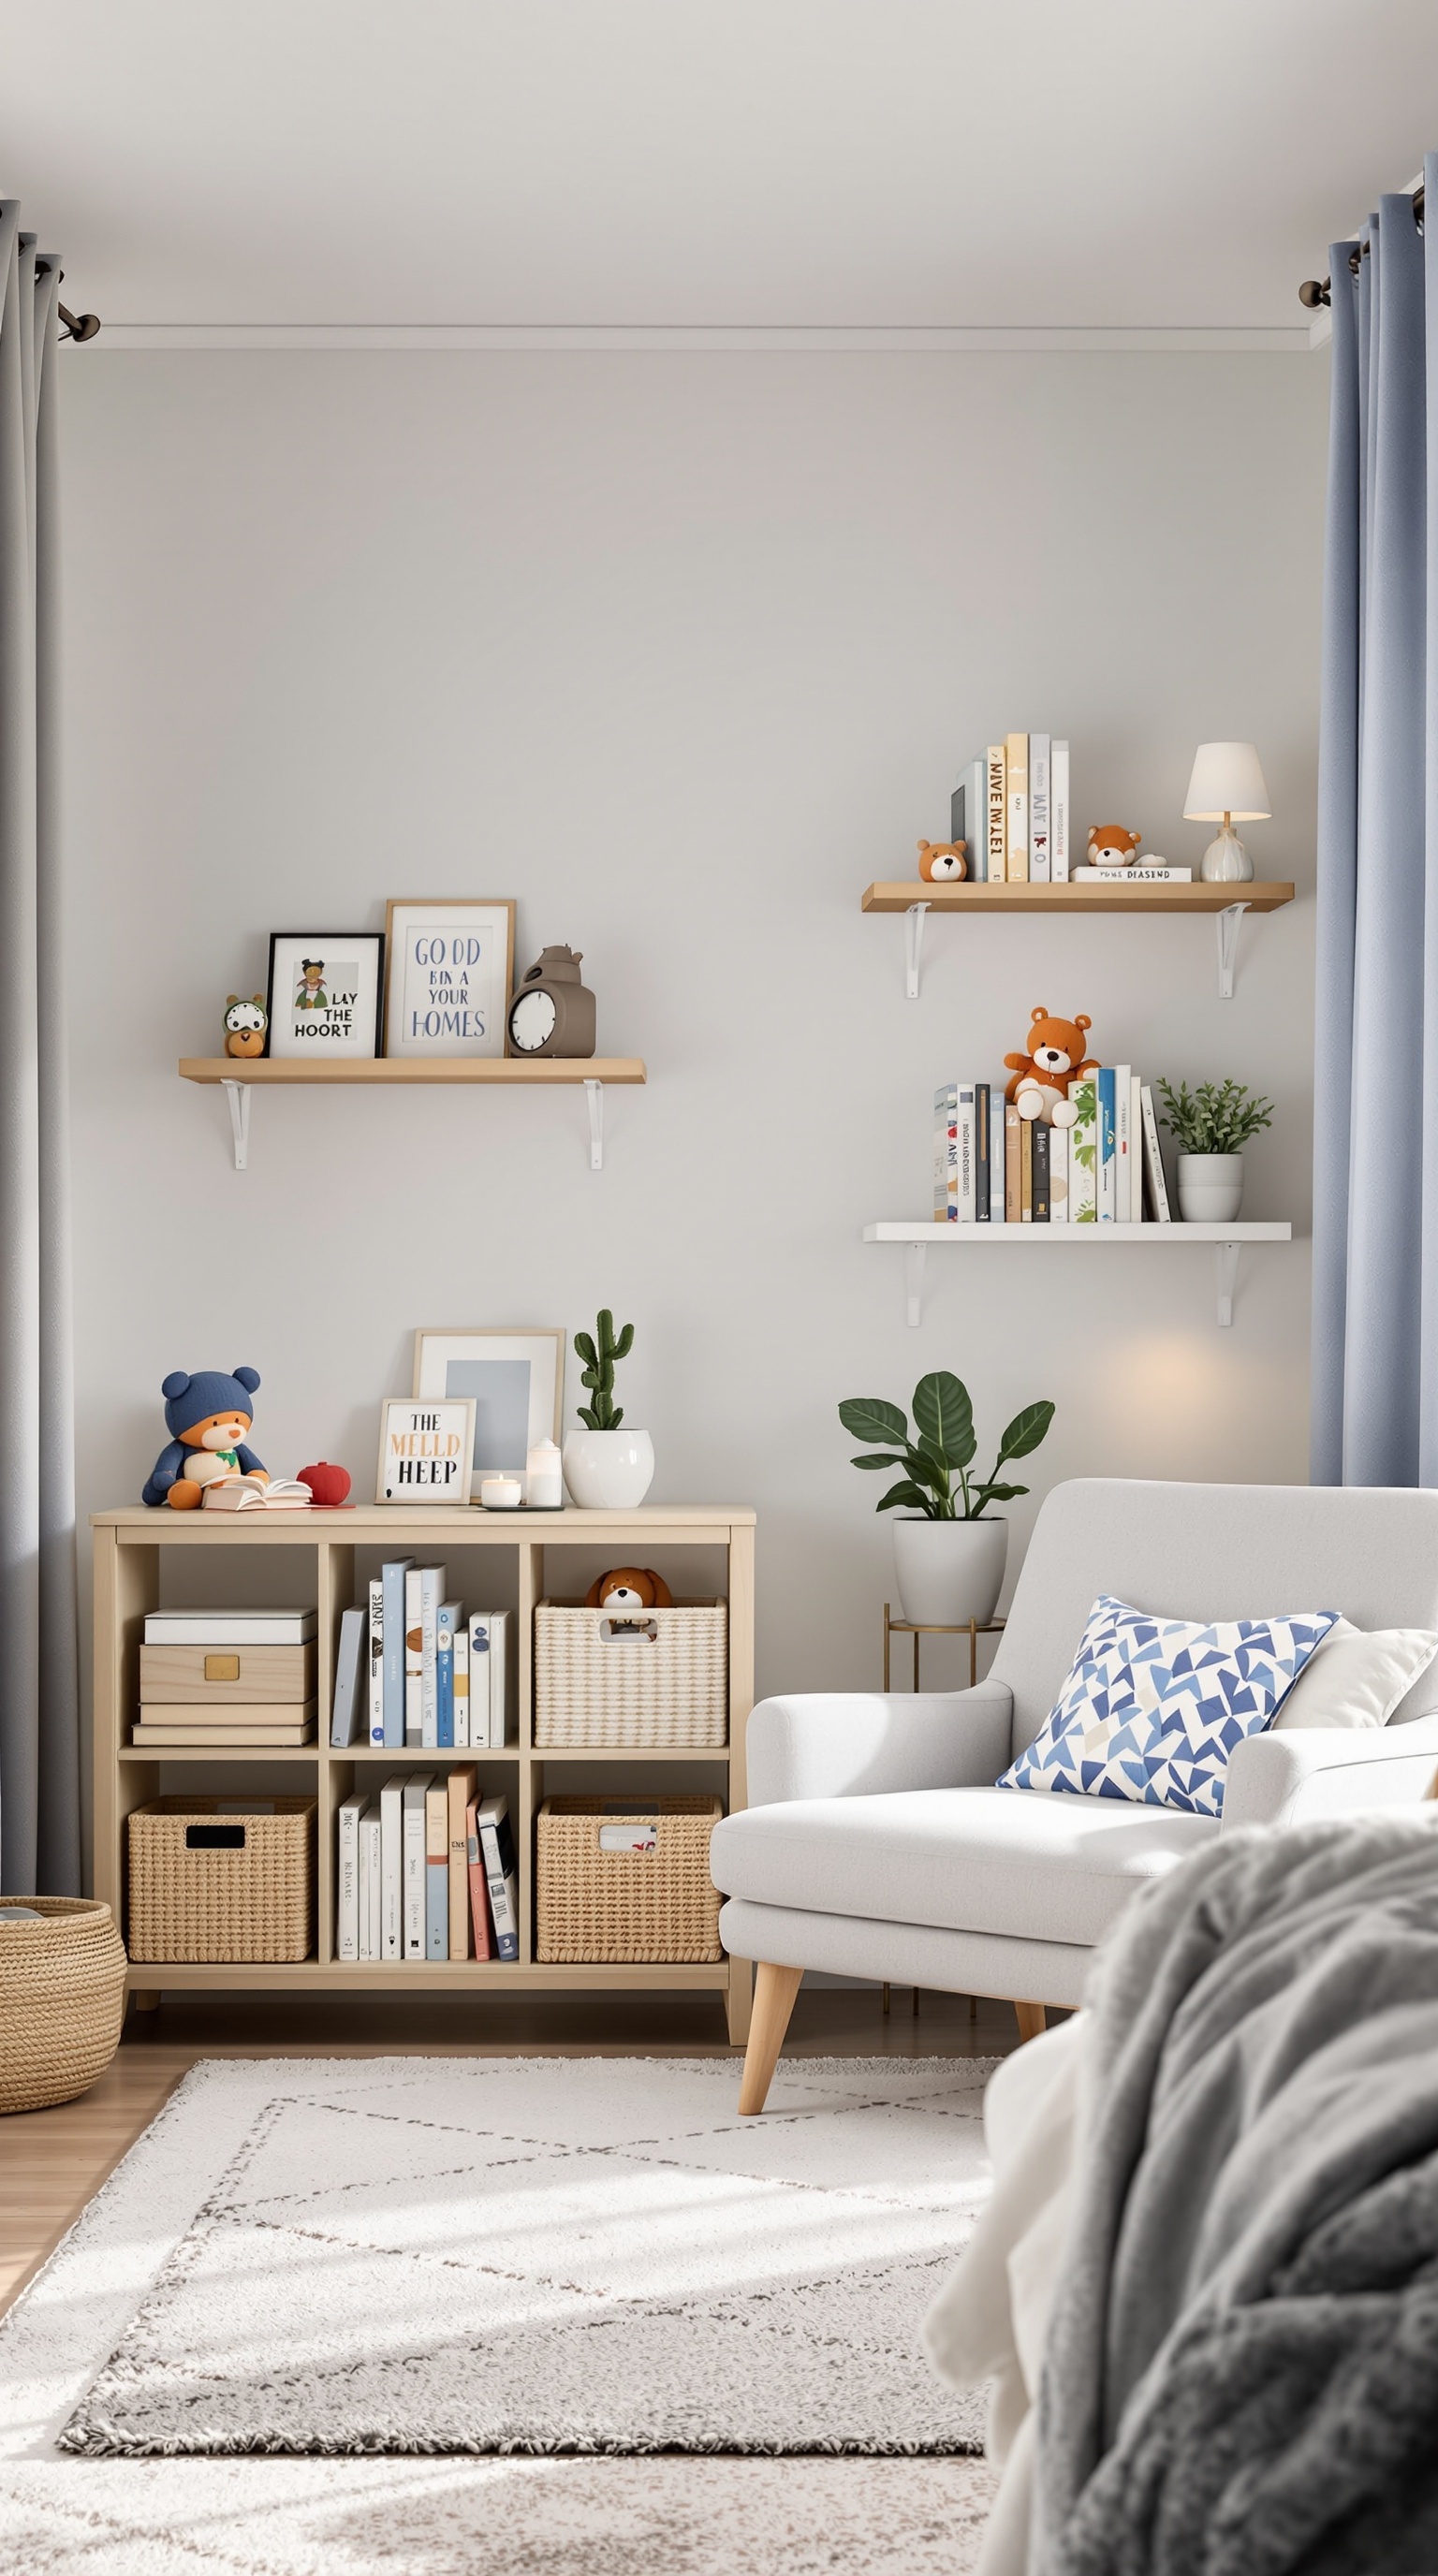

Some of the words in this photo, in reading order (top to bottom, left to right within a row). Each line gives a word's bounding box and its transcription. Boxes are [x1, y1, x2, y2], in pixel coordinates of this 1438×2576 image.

[331, 992, 359, 1005] LAY
[429, 989, 469, 1004] YOUR
[323, 1009, 352, 1021] THE
[295, 1024, 352, 1037] HOORT
[411, 1011, 486, 1037] HOMES
[410, 1413, 441, 1431] THE
[390, 1434, 461, 1457] MELLD
[397, 1460, 457, 1484] HEEP
